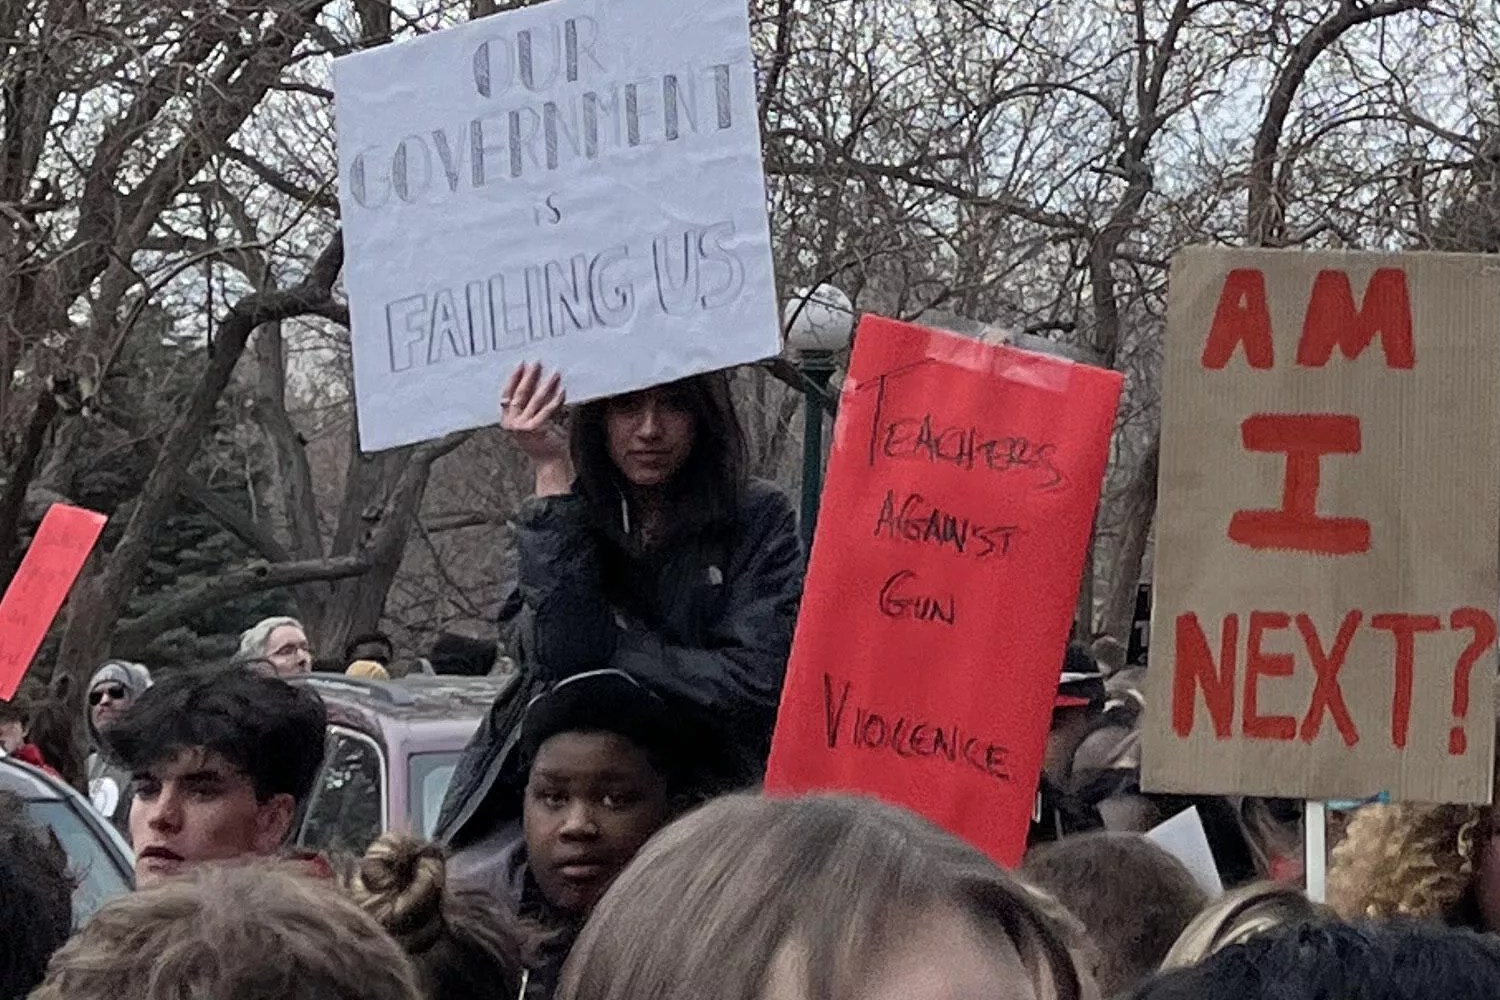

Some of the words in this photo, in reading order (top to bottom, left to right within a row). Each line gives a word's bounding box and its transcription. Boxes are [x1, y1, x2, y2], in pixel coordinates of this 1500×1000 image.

[472, 14, 604, 98] OUR
[349, 56, 743, 209] GOVERNMENT
[385, 244, 635, 373] FAILING
[652, 220, 746, 317] US
[1200, 267, 1416, 371] AM
[873, 488, 1018, 558] AGAINST
[1226, 411, 1373, 556] I
[823, 671, 1010, 781] VIOLENCE
[1171, 607, 1498, 756] NEXT?
